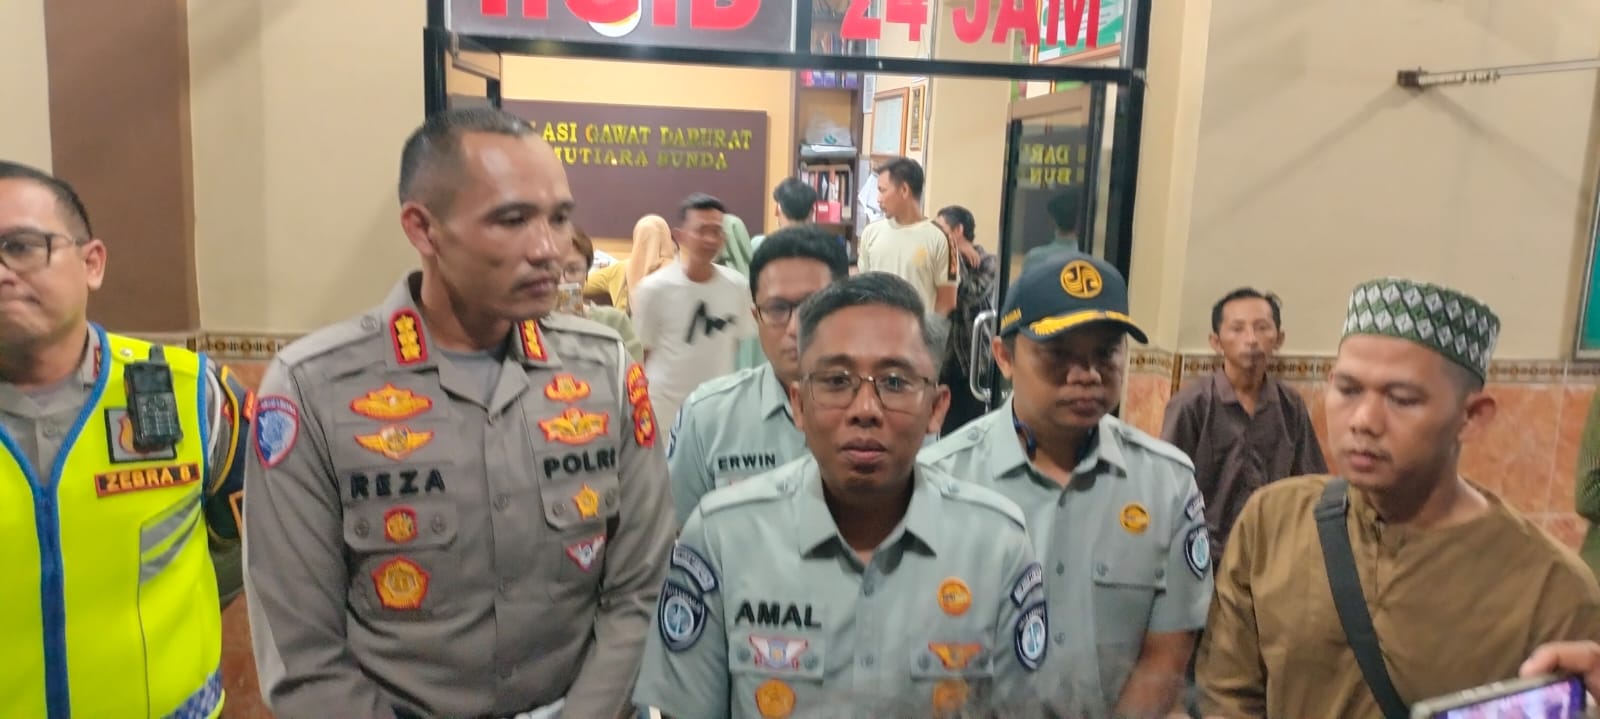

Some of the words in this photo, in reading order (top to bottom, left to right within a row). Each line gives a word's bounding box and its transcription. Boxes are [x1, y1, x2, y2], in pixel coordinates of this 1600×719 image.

[585, 123, 652, 146] GAWAT
[543, 448, 617, 479] POLRI
[717, 452, 777, 471] ERWIN
[106, 466, 174, 492] ZEBRA
[350, 468, 446, 499] REZA
[734, 600, 822, 628] AMAL
